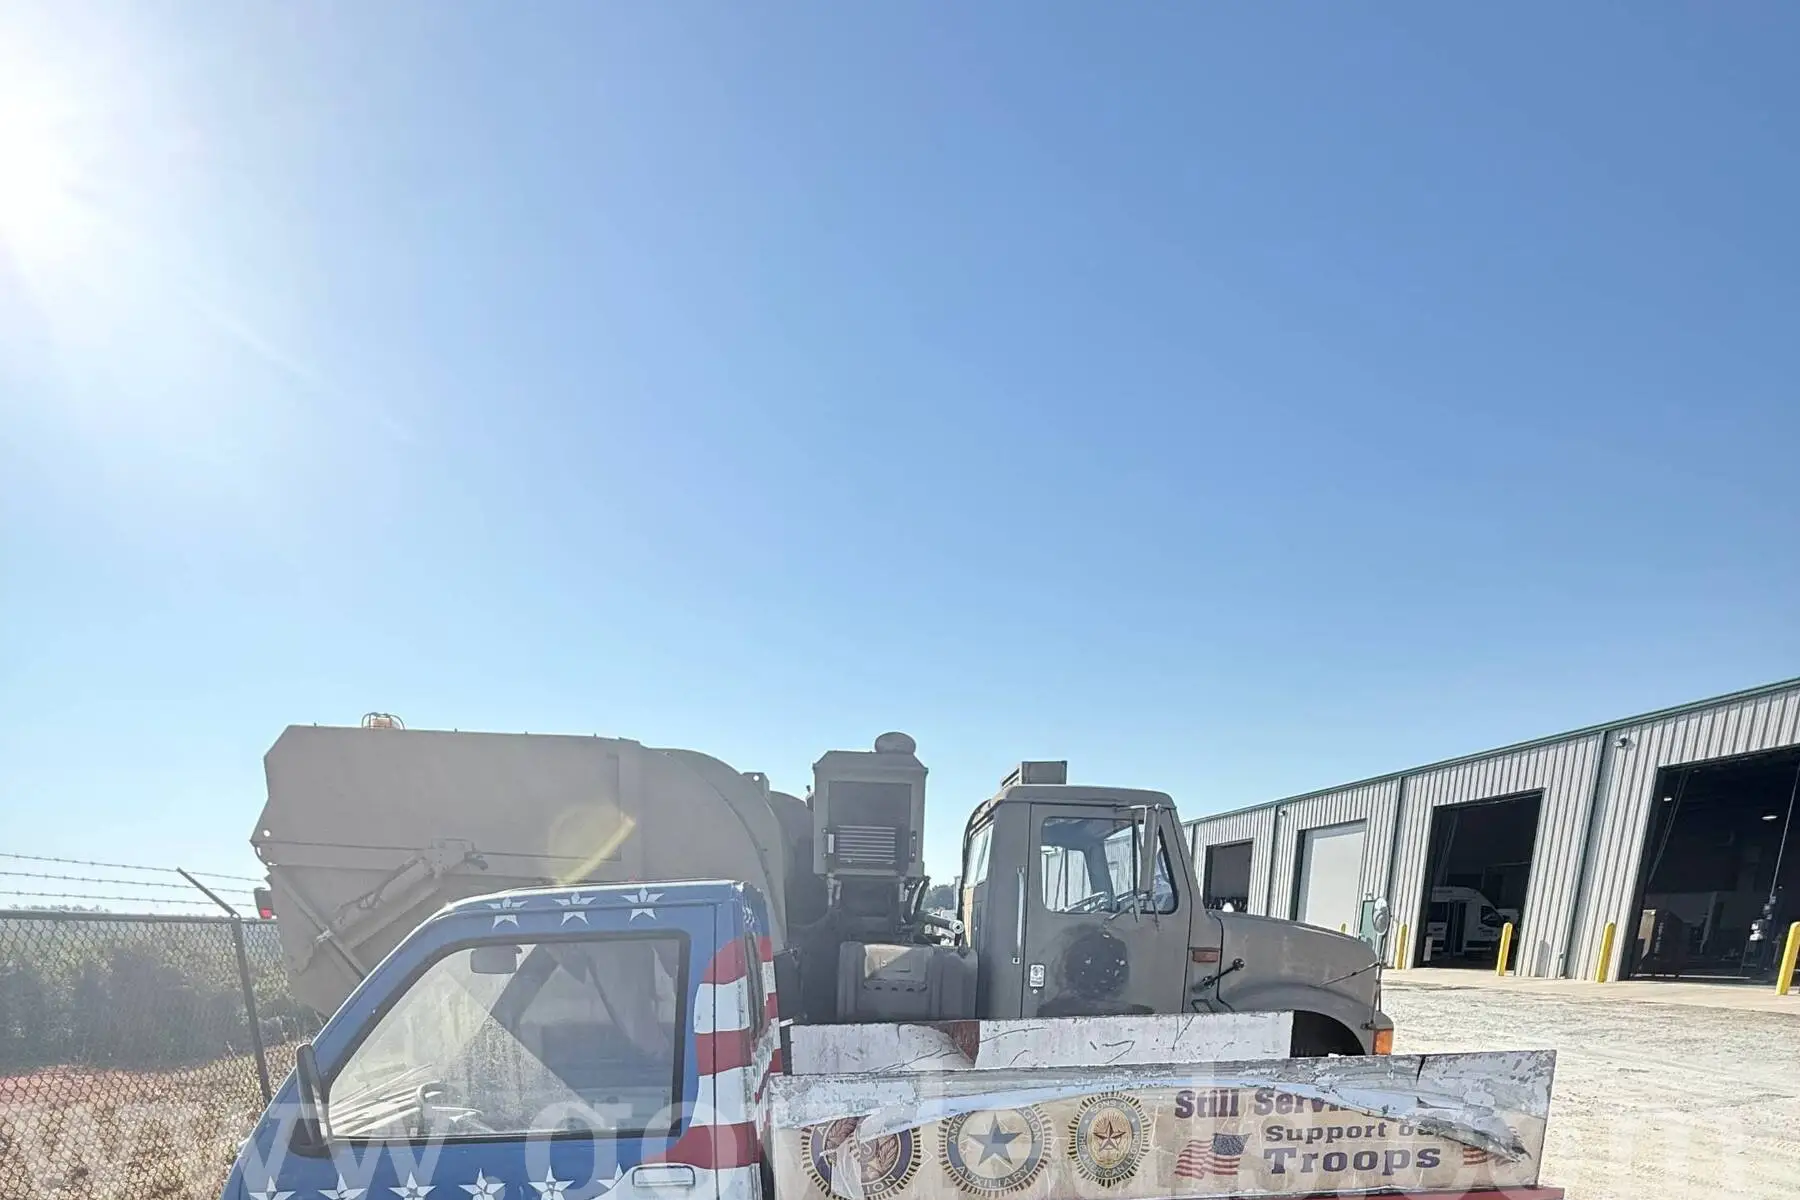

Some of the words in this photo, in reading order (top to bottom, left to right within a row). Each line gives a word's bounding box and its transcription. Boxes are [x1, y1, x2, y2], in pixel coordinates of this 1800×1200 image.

[1174, 1087, 1240, 1118] Still
[1265, 1122, 1386, 1144] Support
[1263, 1148, 1441, 1176] Troops
[955, 1165, 1030, 1190] AUXILIARY
